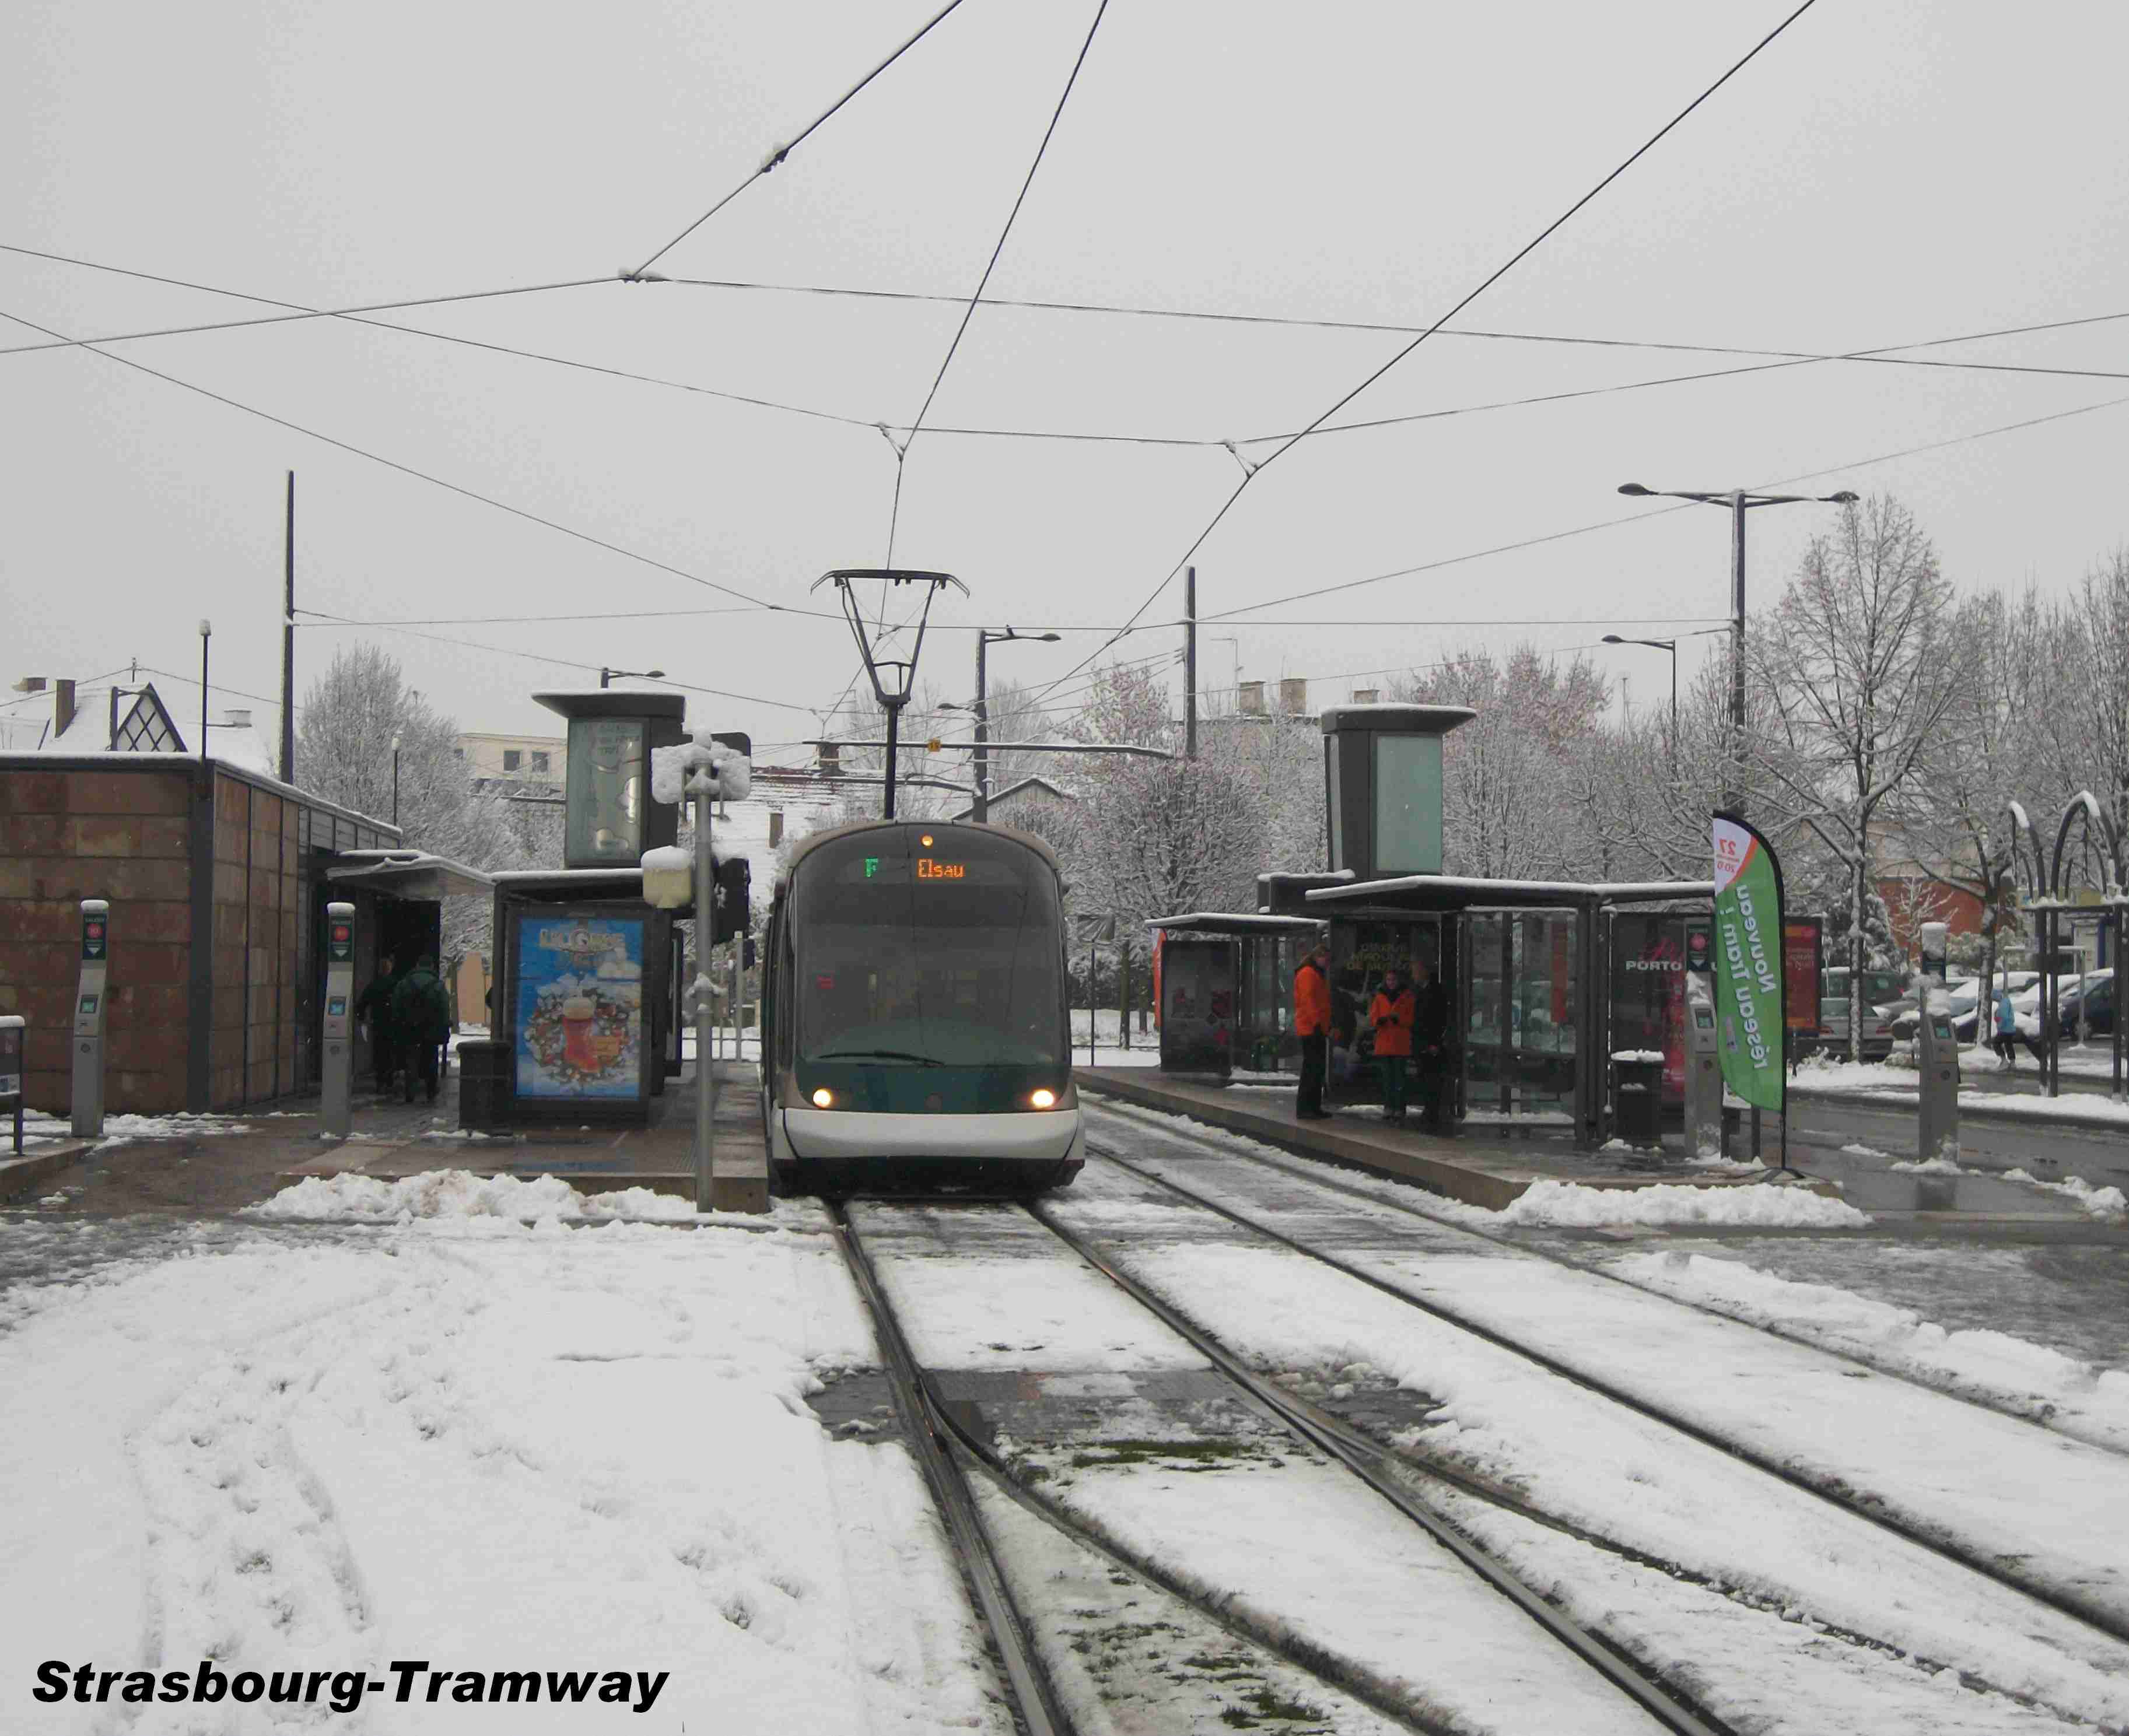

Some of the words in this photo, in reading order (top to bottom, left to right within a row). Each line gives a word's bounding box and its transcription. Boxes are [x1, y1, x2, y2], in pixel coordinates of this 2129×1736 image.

[866, 858, 878, 877] F
[918, 858, 964, 877] Elsau
[1625, 960, 1682, 972] PORTO
